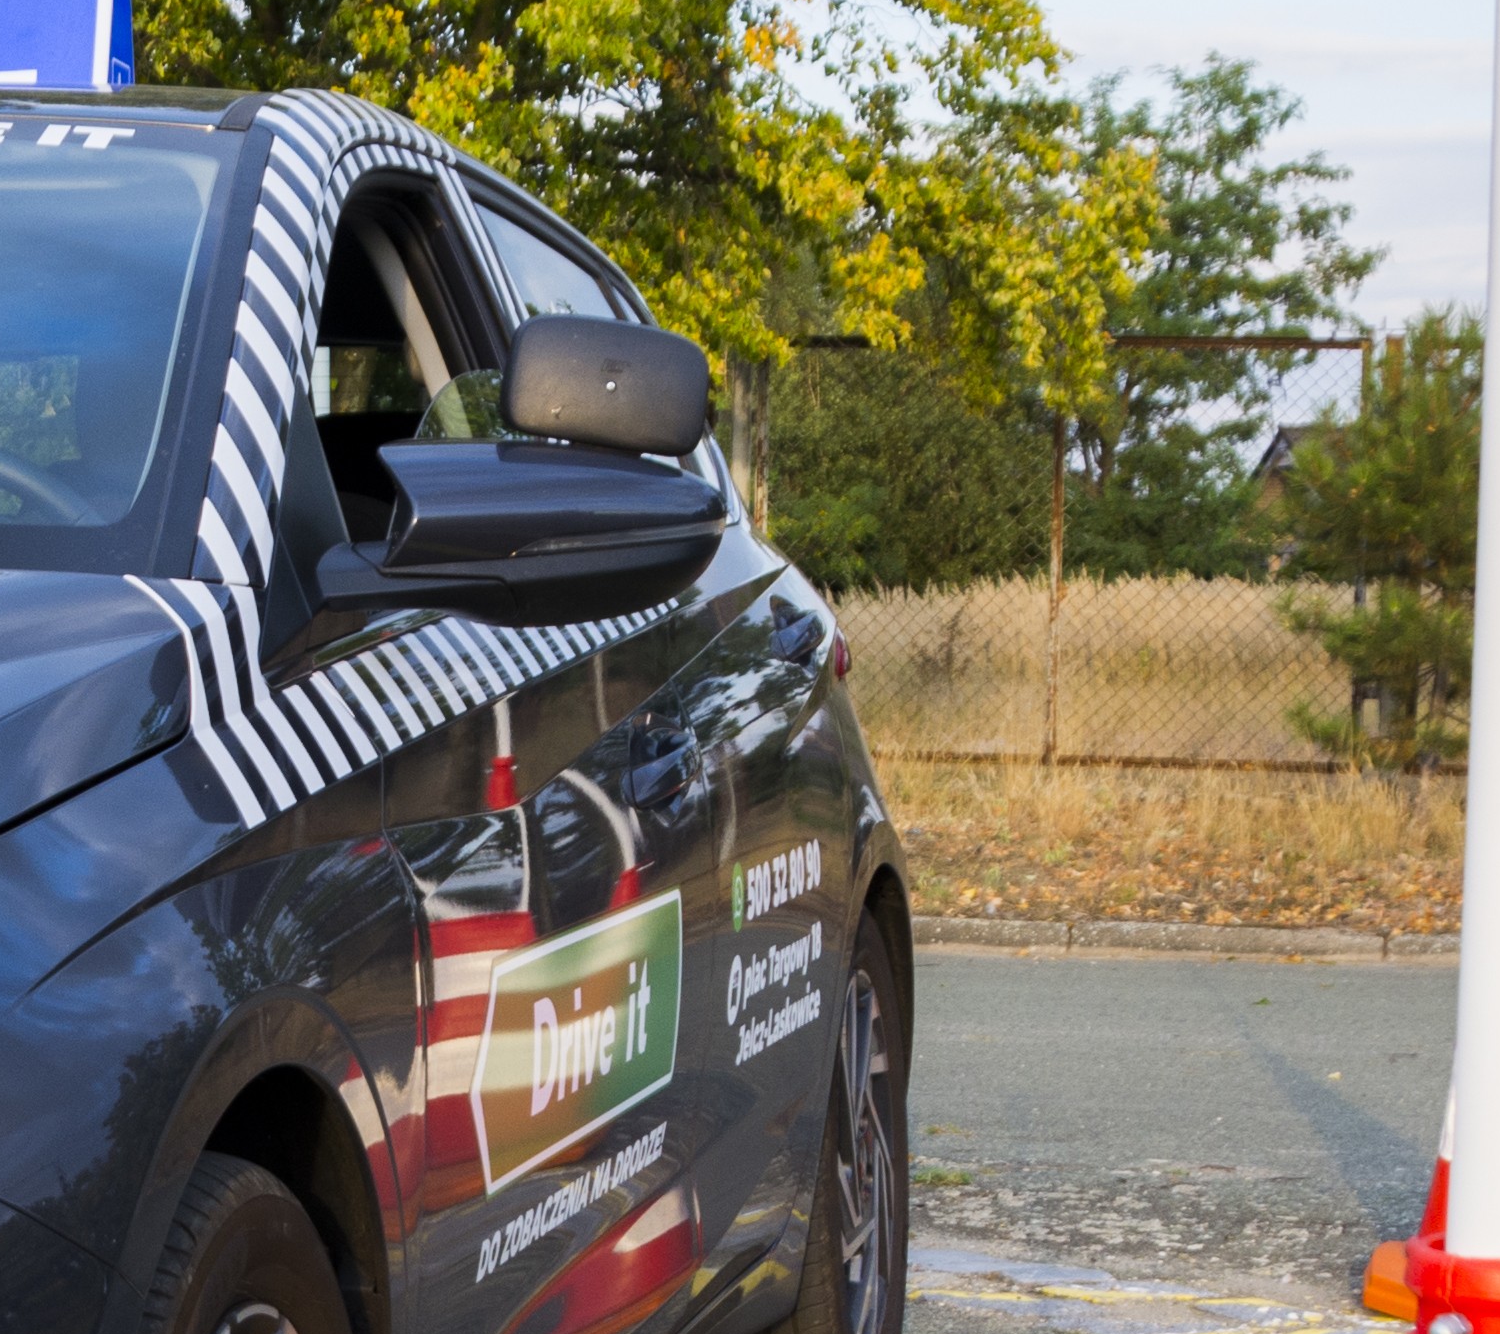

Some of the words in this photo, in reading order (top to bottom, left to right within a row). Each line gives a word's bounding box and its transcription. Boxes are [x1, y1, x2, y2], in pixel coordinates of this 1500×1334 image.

[36, 124, 136, 150] IT
[747, 861, 771, 921] 500
[773, 853, 788, 908] 32
[789, 845, 805, 900] 80
[805, 838, 821, 891] 90
[743, 953, 767, 1010] plac
[769, 932, 811, 987] Targowy
[811, 921, 822, 962] 18
[531, 986, 616, 1116] Drive
[626, 957, 650, 1062] it
[735, 981, 821, 1066] Jelcz-Laskowice
[476, 1230, 502, 1283] DO
[500, 1171, 591, 1265] ZOBACZENIA
[590, 1158, 612, 1203] NA
[611, 1121, 667, 1190] DRODZE!
